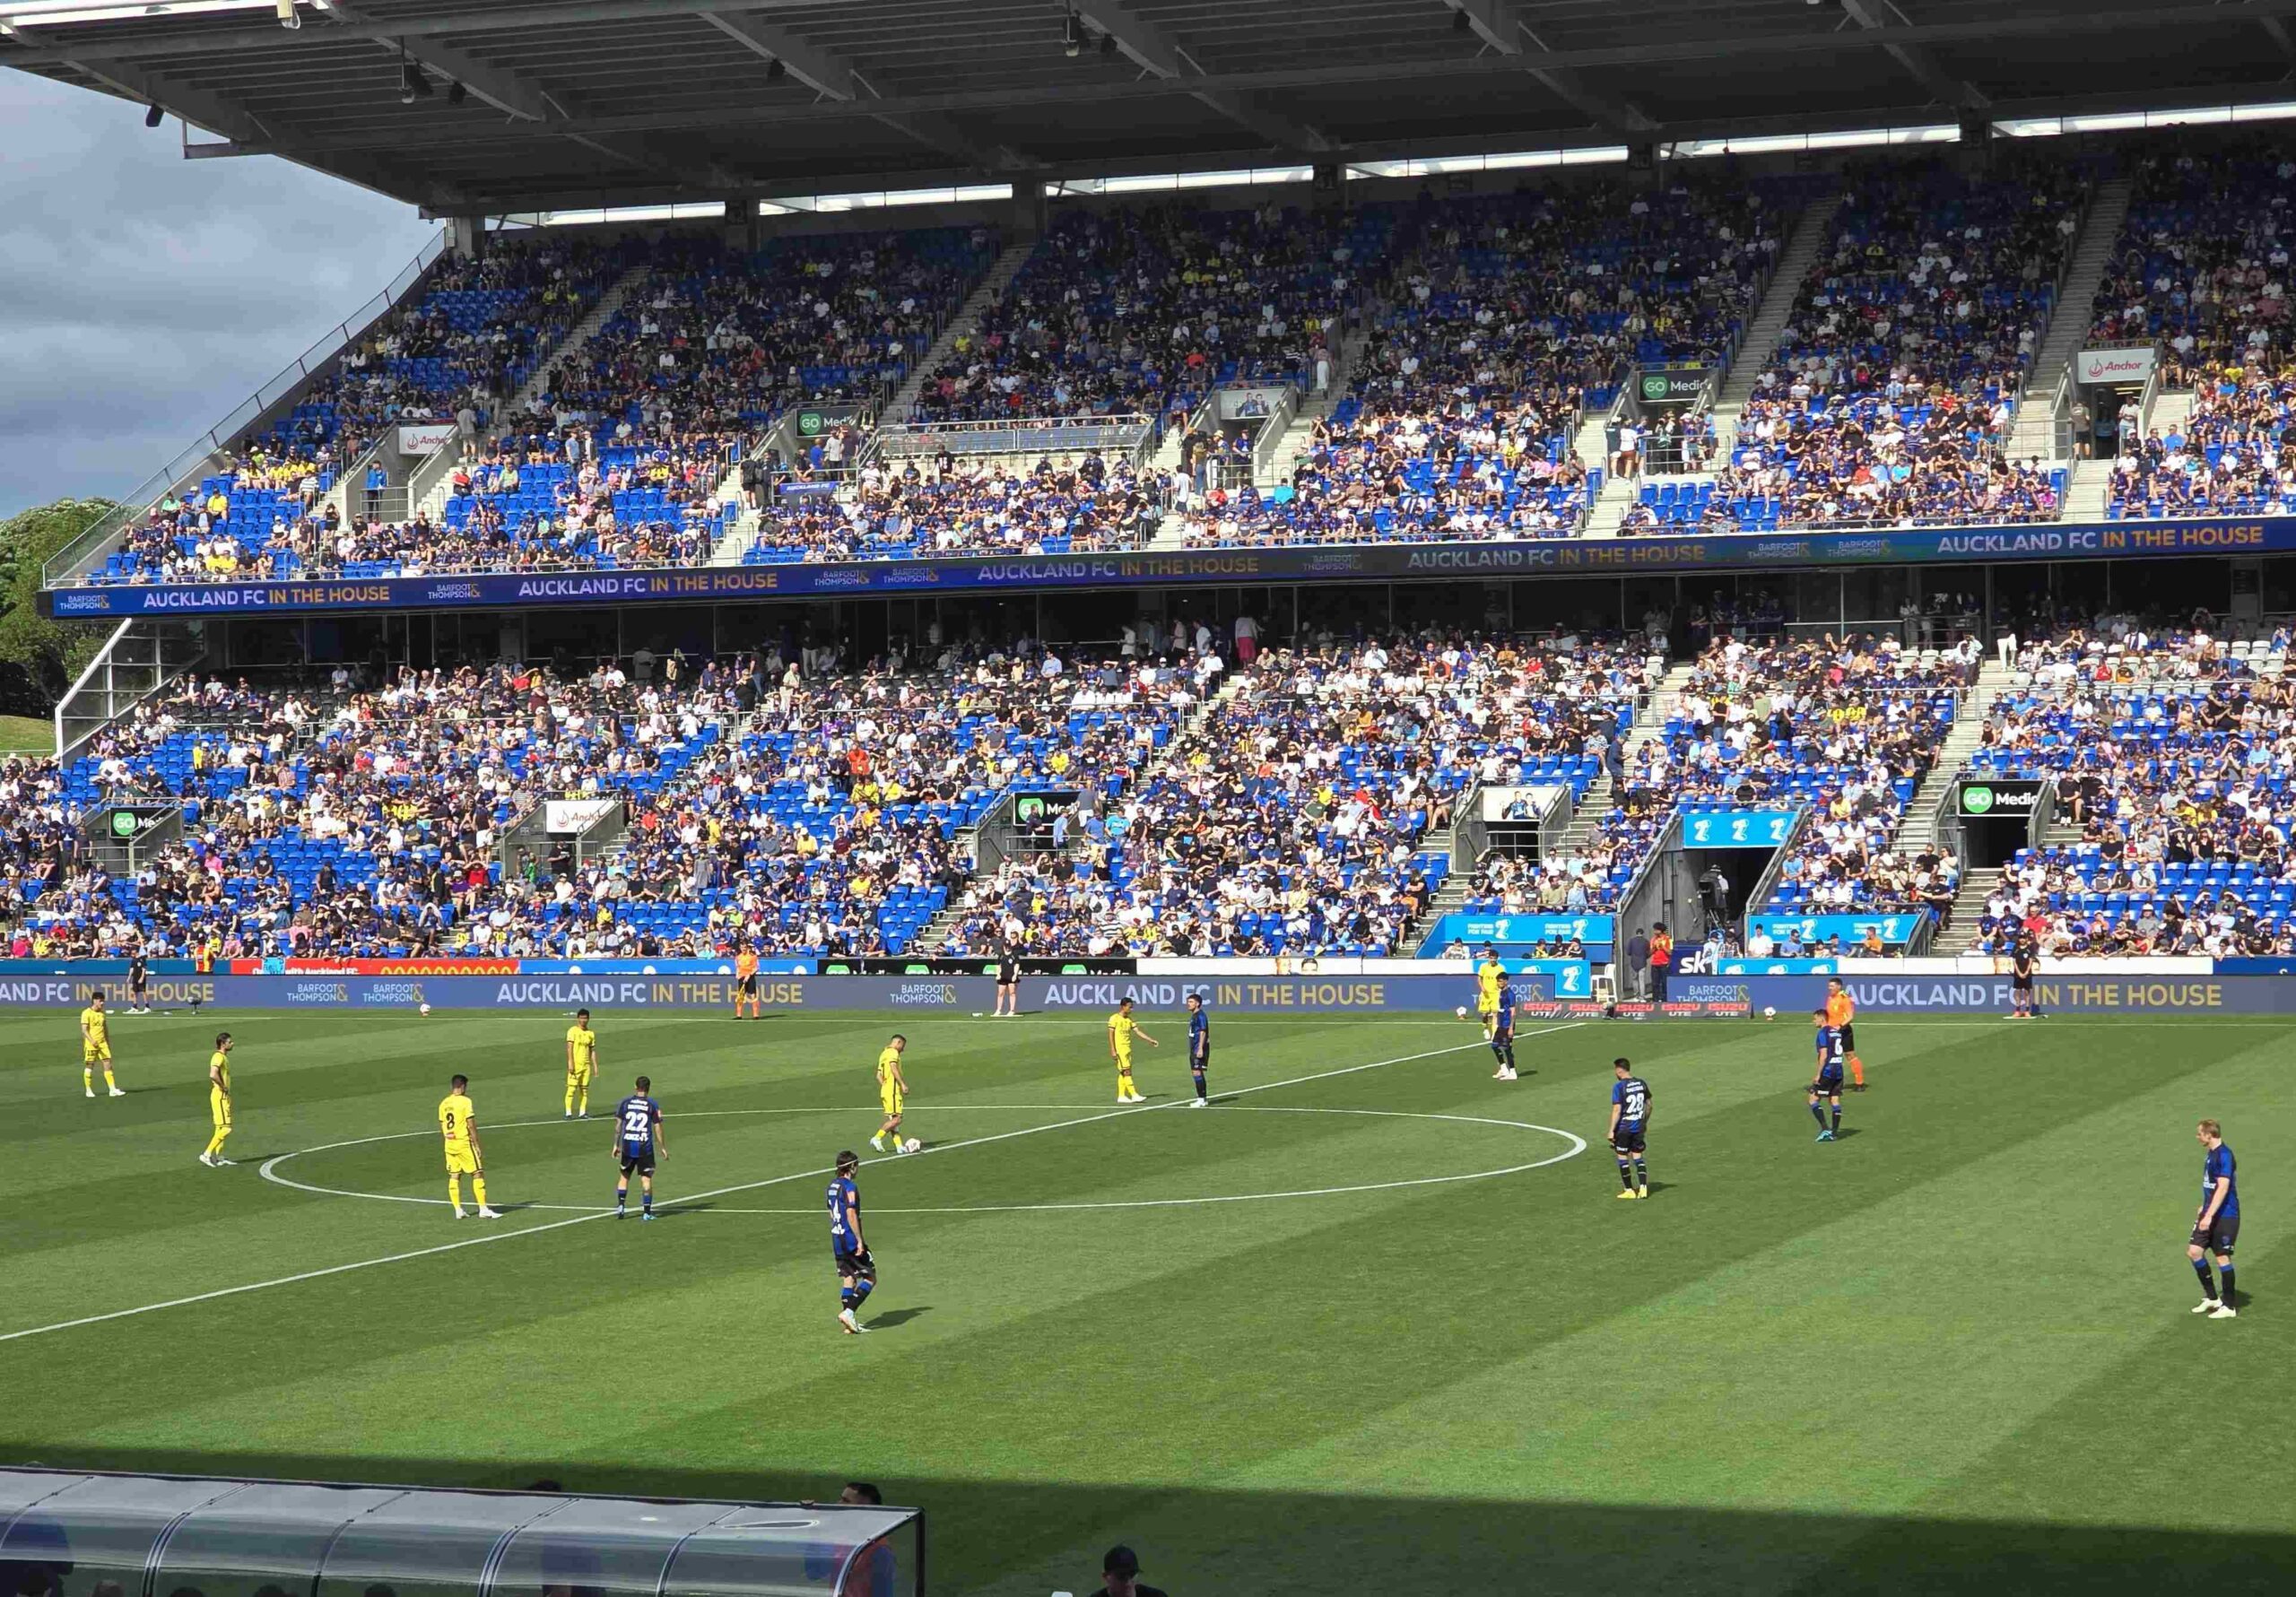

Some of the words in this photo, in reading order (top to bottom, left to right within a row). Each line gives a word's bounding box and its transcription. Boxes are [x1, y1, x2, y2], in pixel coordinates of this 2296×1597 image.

[2105, 360, 2144, 370] Anchor
[1645, 381, 1665, 392] GO
[420, 435, 447, 444] Ancho
[1937, 533, 2062, 552] AUCKLAND
[2069, 532, 2096, 550] FC
[2102, 530, 2125, 548] IN
[2131, 529, 2176, 546] THE
[2181, 526, 2265, 545] HOUSE
[1408, 550, 1522, 568] AUCKLAND
[1528, 549, 1553, 566] FC
[1560, 548, 1580, 564] IN
[1585, 548, 1625, 563] THE
[1631, 545, 1704, 562] HOUSE
[978, 562, 1085, 580] AUCKLAND
[1091, 561, 1116, 577] FC
[1121, 560, 1140, 576] IN
[1145, 559, 1184, 575] THE
[1189, 558, 1259, 574] HOUSE
[519, 578, 619, 596] AUCKLAND
[624, 577, 646, 593] FC
[651, 577, 669, 592] IN
[674, 575, 709, 591] THE
[714, 573, 778, 589] HOUSE
[814, 577, 858, 586] THOMPSON
[437, 584, 471, 592] BARFOOT
[67, 595, 101, 603] BARFOOT
[144, 589, 239, 608] AUCKLAND
[243, 589, 265, 605] FC
[269, 588, 287, 603] IN
[291, 587, 325, 603] THE
[329, 586, 390, 602] HOUSE
[428, 591, 471, 599] THOMPSON
[59, 602, 100, 610] THOMPSON
[571, 812, 600, 821] Ancho
[1679, 950, 1707, 974] sk
[46, 983, 70, 1002] FC
[75, 983, 95, 1002] IN
[145, 983, 214, 1002] HOUSE
[298, 984, 337, 993] BARFOOT
[373, 984, 414, 993] BARFOOT
[497, 983, 614, 1002] AUCKLAND
[621, 983, 647, 1002] FC
[652, 983, 673, 1002] IN
[679, 983, 721, 1002] THE
[901, 985, 944, 994] BARFOOT
[1690, 985, 1737, 995] BARFOOT
[287, 993, 337, 1002] THOMPSON
[363, 993, 413, 1002] THOMPSON
[891, 994, 944, 1003] THOMPSON
[1044, 985, 1176, 1005] AUCKLAND
[1182, 985, 1211, 1005] FC
[1217, 985, 1241, 1005] IN
[1247, 985, 1293, 1005] THE
[1300, 985, 1384, 1005] HOUSE
[1845, 985, 1986, 1005] AUCKLAND
[2034, 985, 2059, 1005] IN
[2067, 985, 2119, 1005] THE
[2128, 985, 2222, 1005] HOUSE
[1616, 1003, 1654, 1011] ISUZU
[1661, 1003, 1700, 1011] ISUZU
[1708, 1003, 1748, 1011] ISUZU
[1835, 1037, 1843, 1055] 6
[1626, 1092, 1645, 1114] 28
[447, 1112, 455, 1130] 8
[625, 1111, 648, 1133] 22
